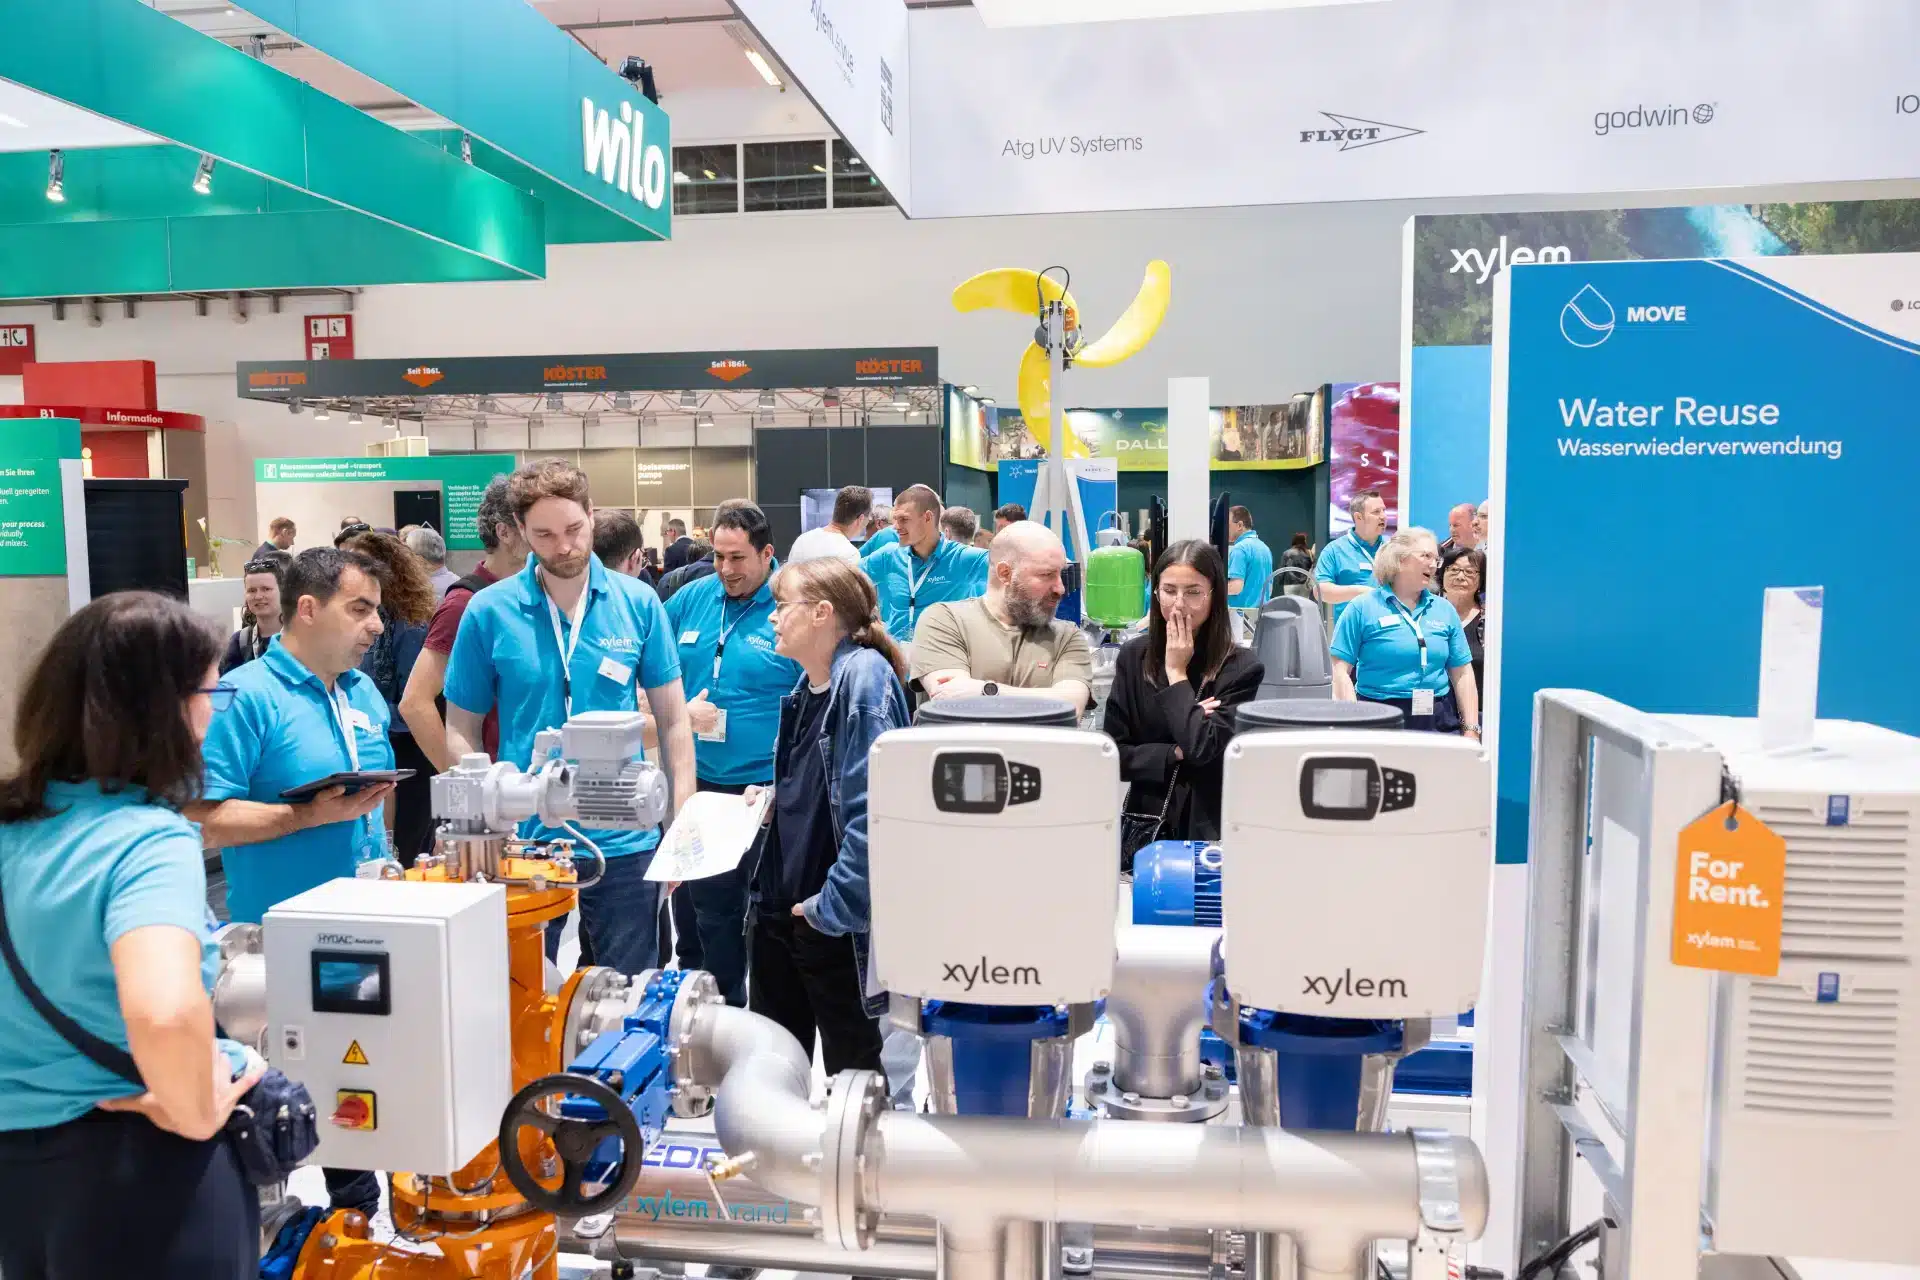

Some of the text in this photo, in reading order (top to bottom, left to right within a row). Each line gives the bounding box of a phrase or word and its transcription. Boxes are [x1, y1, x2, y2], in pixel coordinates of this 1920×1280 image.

[1594, 103, 1688, 136] godwin
[1299, 127, 1381, 143] FLYGT
[582, 97, 665, 209] wilo
[1001, 135, 1143, 160] Atg UV Systems
[1449, 235, 1571, 285] xylem
[1627, 306, 1686, 323] MOVE
[711, 361, 726, 369] Seit
[856, 358, 924, 375] KÖSTER
[40, 409, 55, 419] B1
[106, 411, 164, 424] Information
[1558, 396, 1780, 427] Water Reuse
[1116, 438, 1168, 451] DALL
[1557, 435, 1843, 460] Wasserwiederverwendung
[2, 521, 45, 530] your process
[927, 575, 946, 584] xylem
[747, 635, 772, 649] xylem
[1689, 850, 1744, 880] For
[1688, 875, 1771, 908] Rent.
[1686, 929, 1737, 949] xylem
[942, 955, 1042, 992] xylem
[1302, 967, 1408, 1005] xylem
[636, 1188, 709, 1222] xylem
